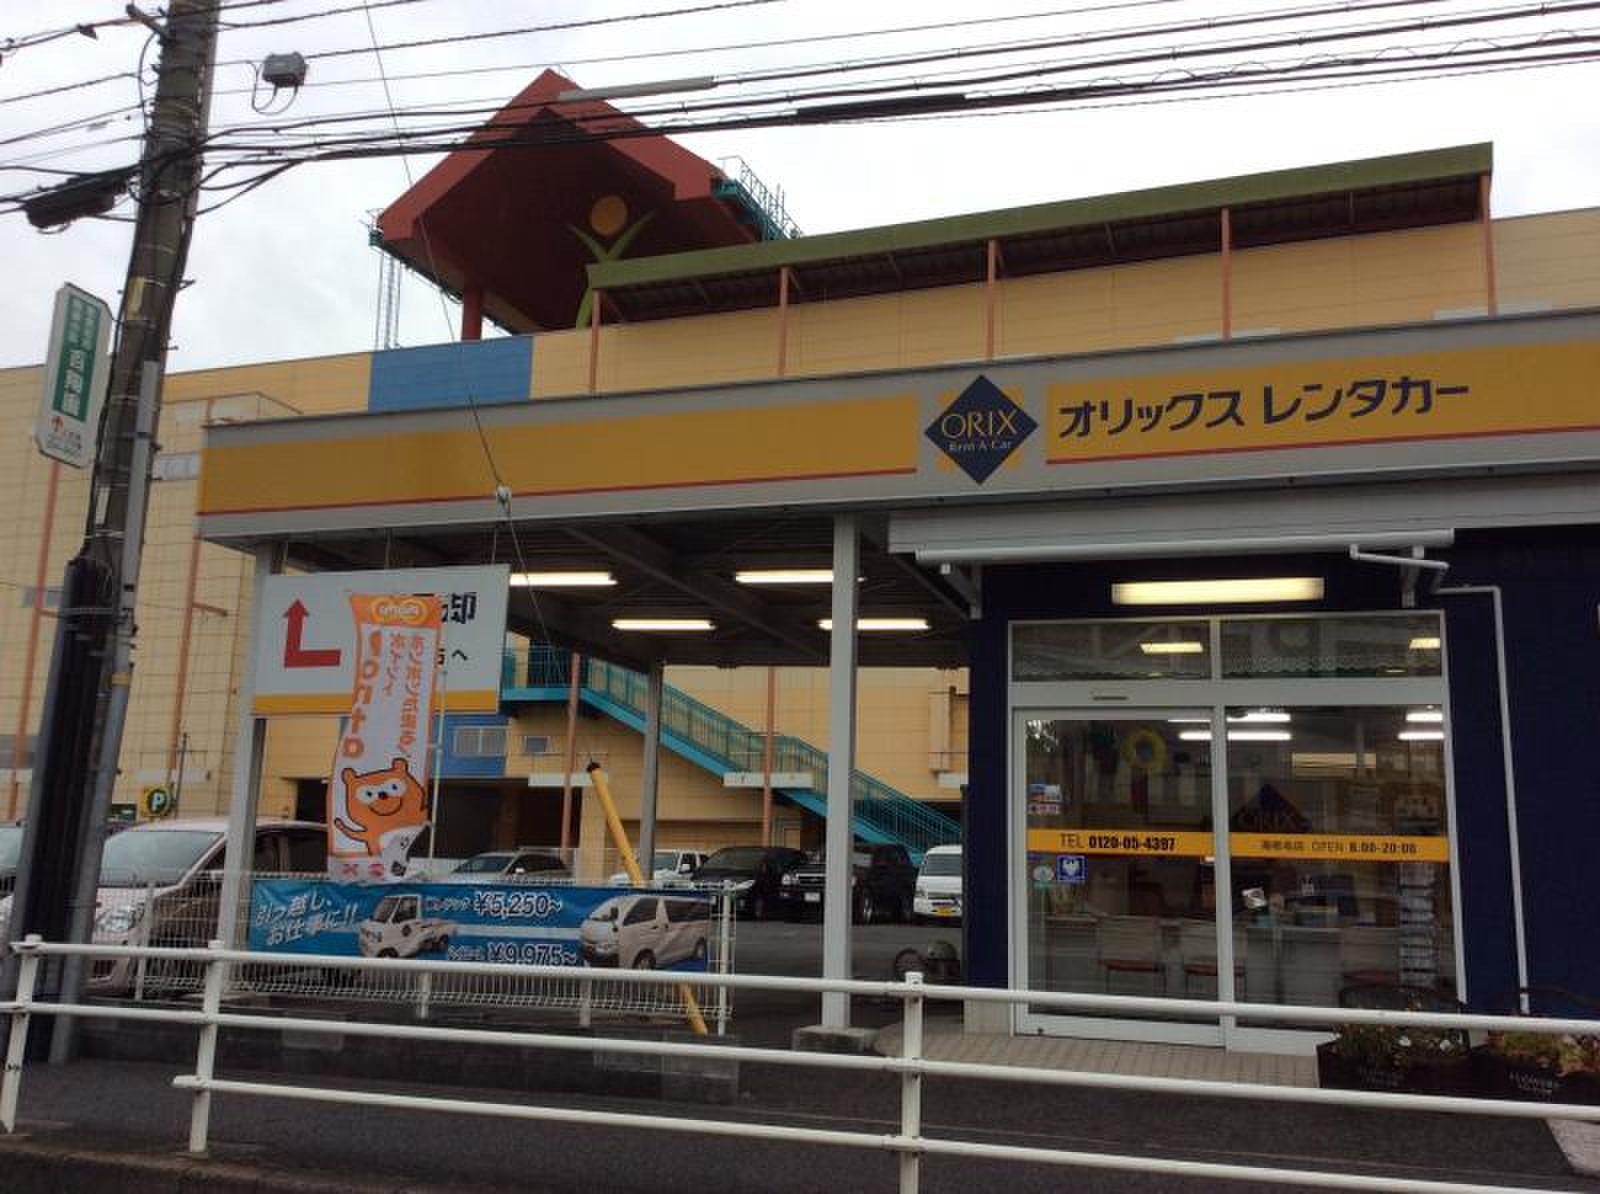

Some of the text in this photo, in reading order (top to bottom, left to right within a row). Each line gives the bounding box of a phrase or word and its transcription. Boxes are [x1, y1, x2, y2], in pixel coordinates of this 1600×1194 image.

[1058, 376, 1470, 439] オリックス レンタカー
[941, 409, 1018, 439] ORIX
[151, 792, 166, 811] P
[1060, 834, 1084, 849] TEL
